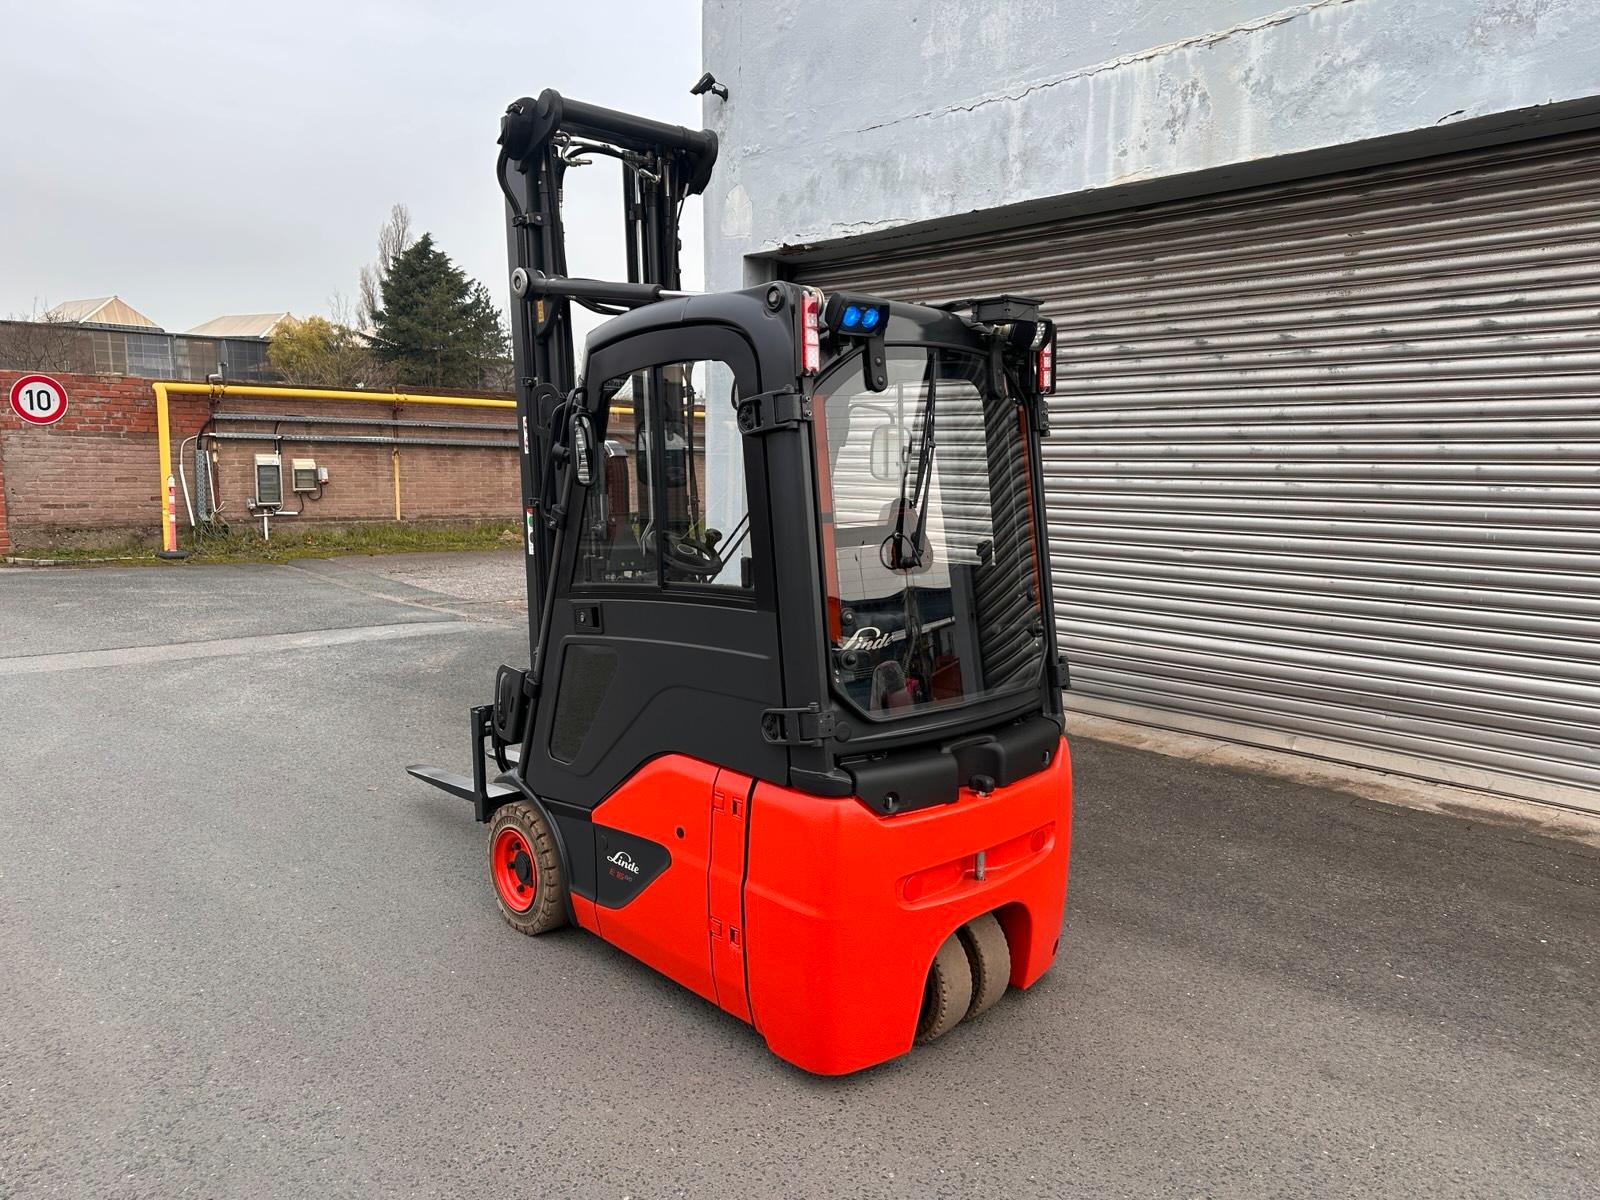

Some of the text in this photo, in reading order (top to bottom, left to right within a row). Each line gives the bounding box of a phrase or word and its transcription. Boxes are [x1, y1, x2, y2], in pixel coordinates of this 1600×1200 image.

[25, 389, 51, 411] 10
[838, 626, 894, 651] Linde
[606, 851, 640, 875] Linde
